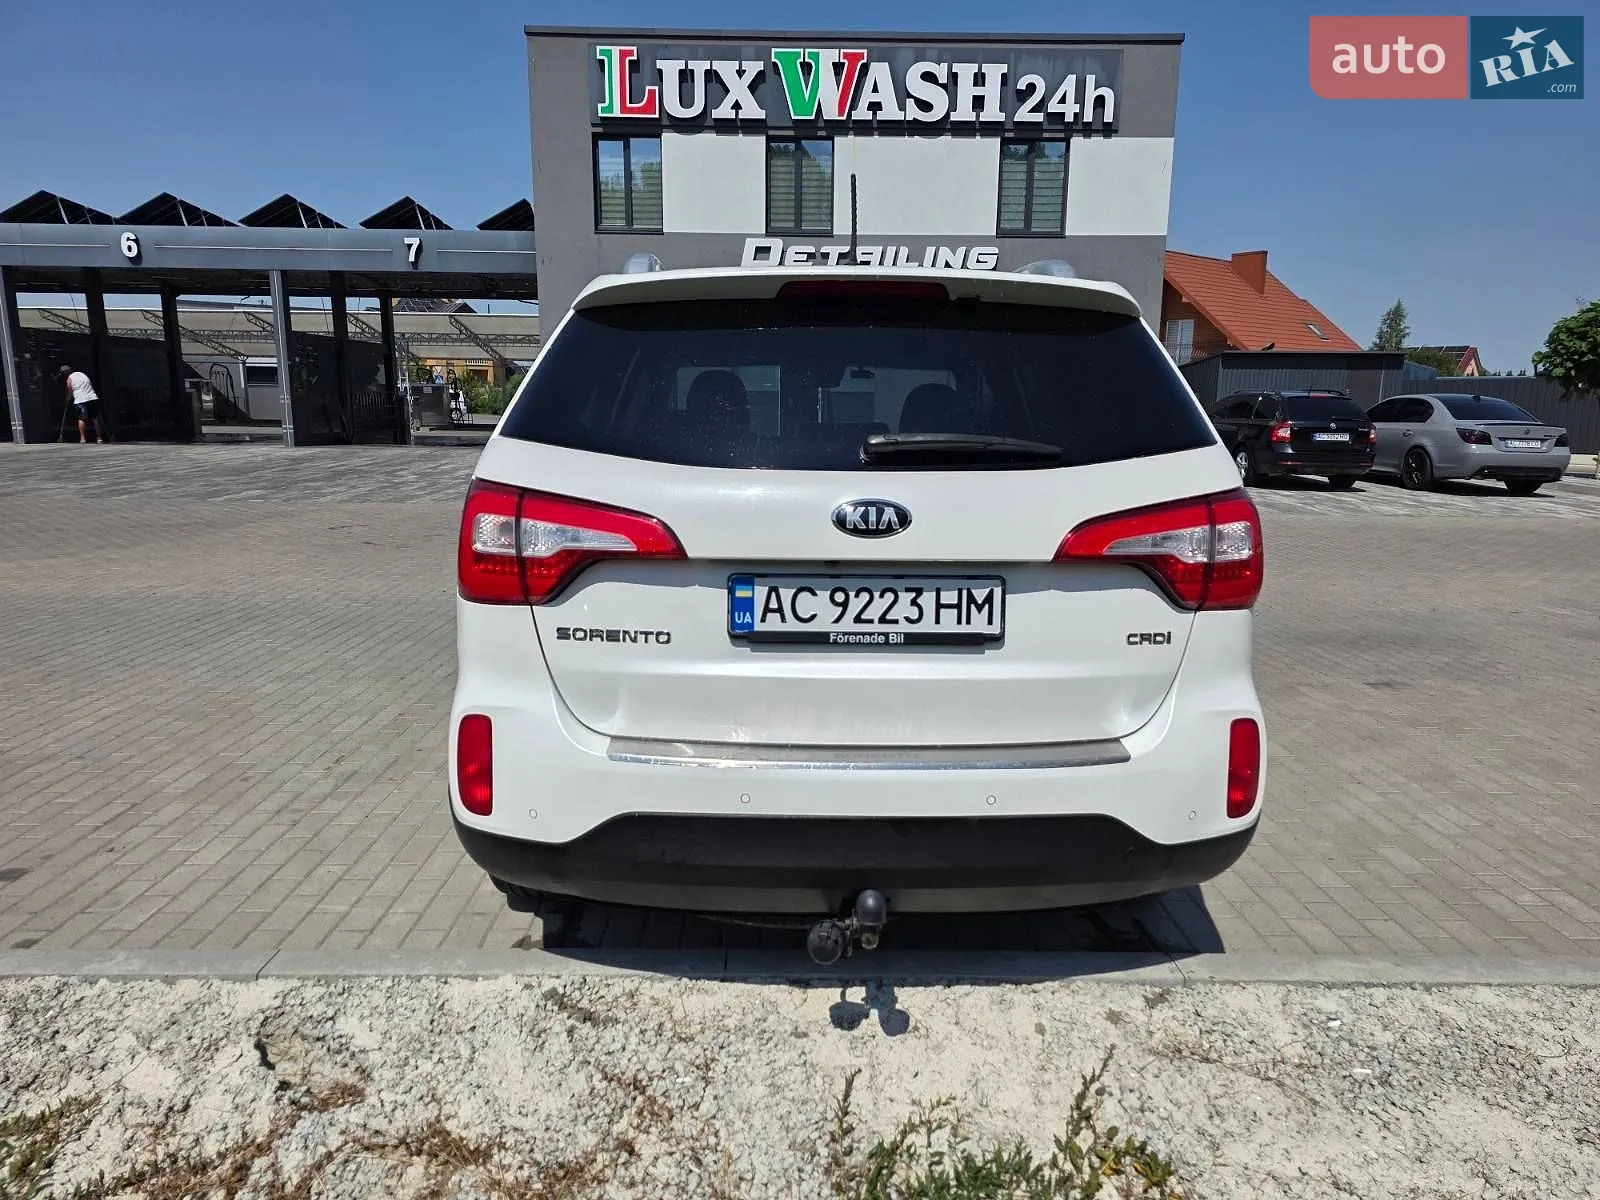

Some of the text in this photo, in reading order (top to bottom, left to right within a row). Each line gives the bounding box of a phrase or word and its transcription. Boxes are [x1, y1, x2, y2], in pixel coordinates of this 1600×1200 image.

[597, 45, 1116, 123] LUX WASH 24h
[121, 231, 138, 258] 6
[404, 237, 420, 262] 7
[846, 506, 900, 529] KIA
[760, 586, 994, 625] AC 9223 HM
[735, 612, 752, 624] UA
[556, 627, 671, 644] SORENTO
[829, 632, 885, 644] Förenade
